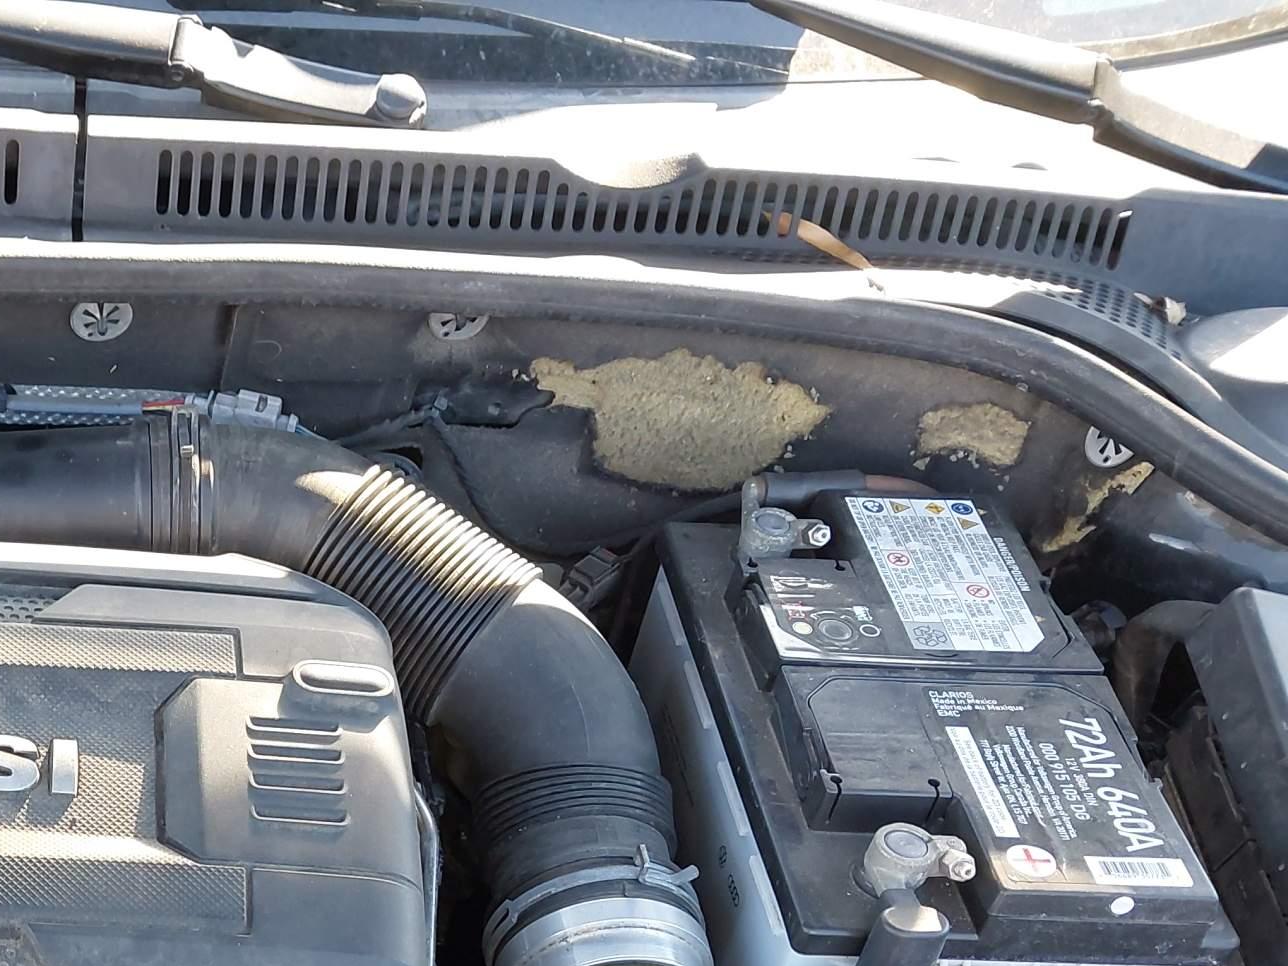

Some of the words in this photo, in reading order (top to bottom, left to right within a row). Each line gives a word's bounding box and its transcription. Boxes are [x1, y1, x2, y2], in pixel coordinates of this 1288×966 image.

[993, 537, 1031, 591] DANGER/POISON
[929, 690, 973, 698] CLARIOS
[1039, 743, 1058, 760] 000
[1049, 763, 1069, 780] 915
[1061, 784, 1080, 801] 105
[1071, 805, 1090, 820] DG
[1059, 718, 1122, 778] 72Ah
[1097, 787, 1164, 852] 640A
[1065, 758, 1080, 771] 12V
[1083, 793, 1099, 806] DIN
